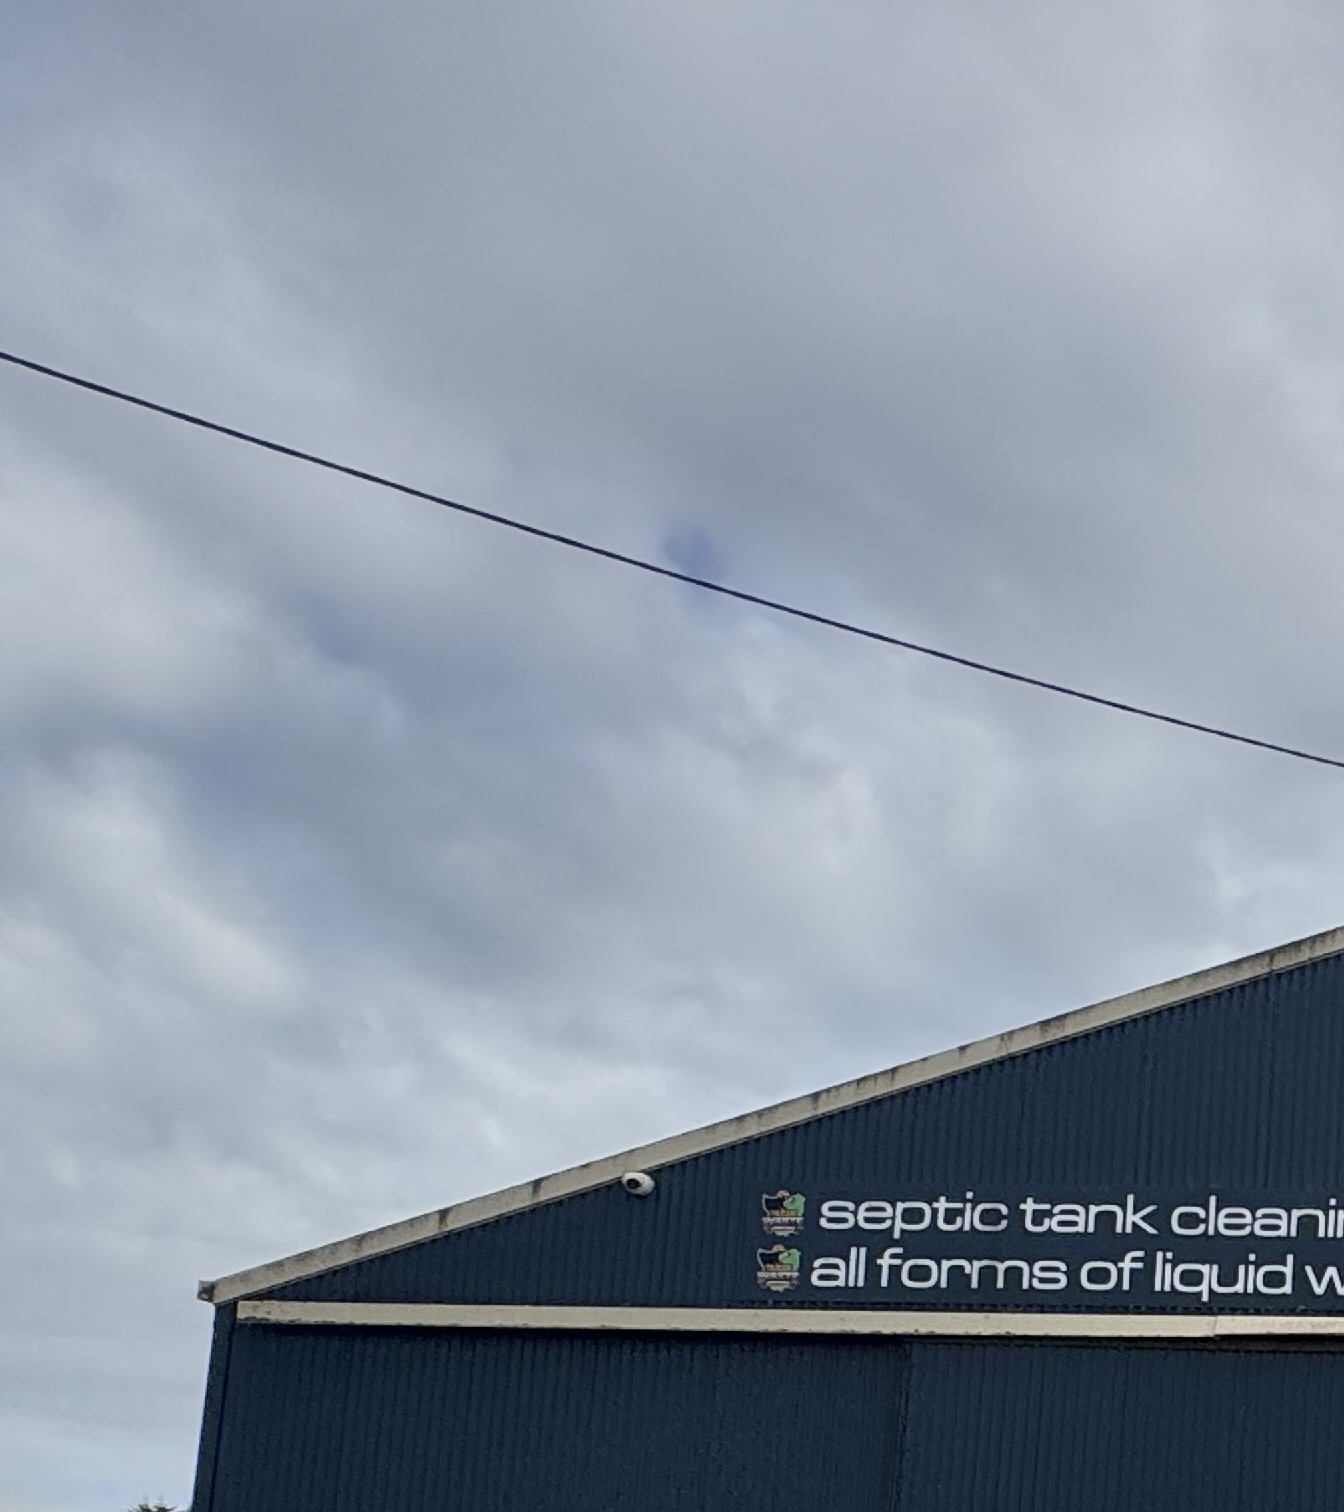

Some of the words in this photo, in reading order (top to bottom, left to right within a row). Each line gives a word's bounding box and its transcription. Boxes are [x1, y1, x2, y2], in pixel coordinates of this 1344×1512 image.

[820, 1192, 1008, 1239] septic
[1020, 1194, 1157, 1233] tank
[811, 1247, 866, 1287] all
[877, 1248, 1067, 1289] forms
[1081, 1251, 1144, 1290] of
[1155, 1251, 1293, 1301] liquid
